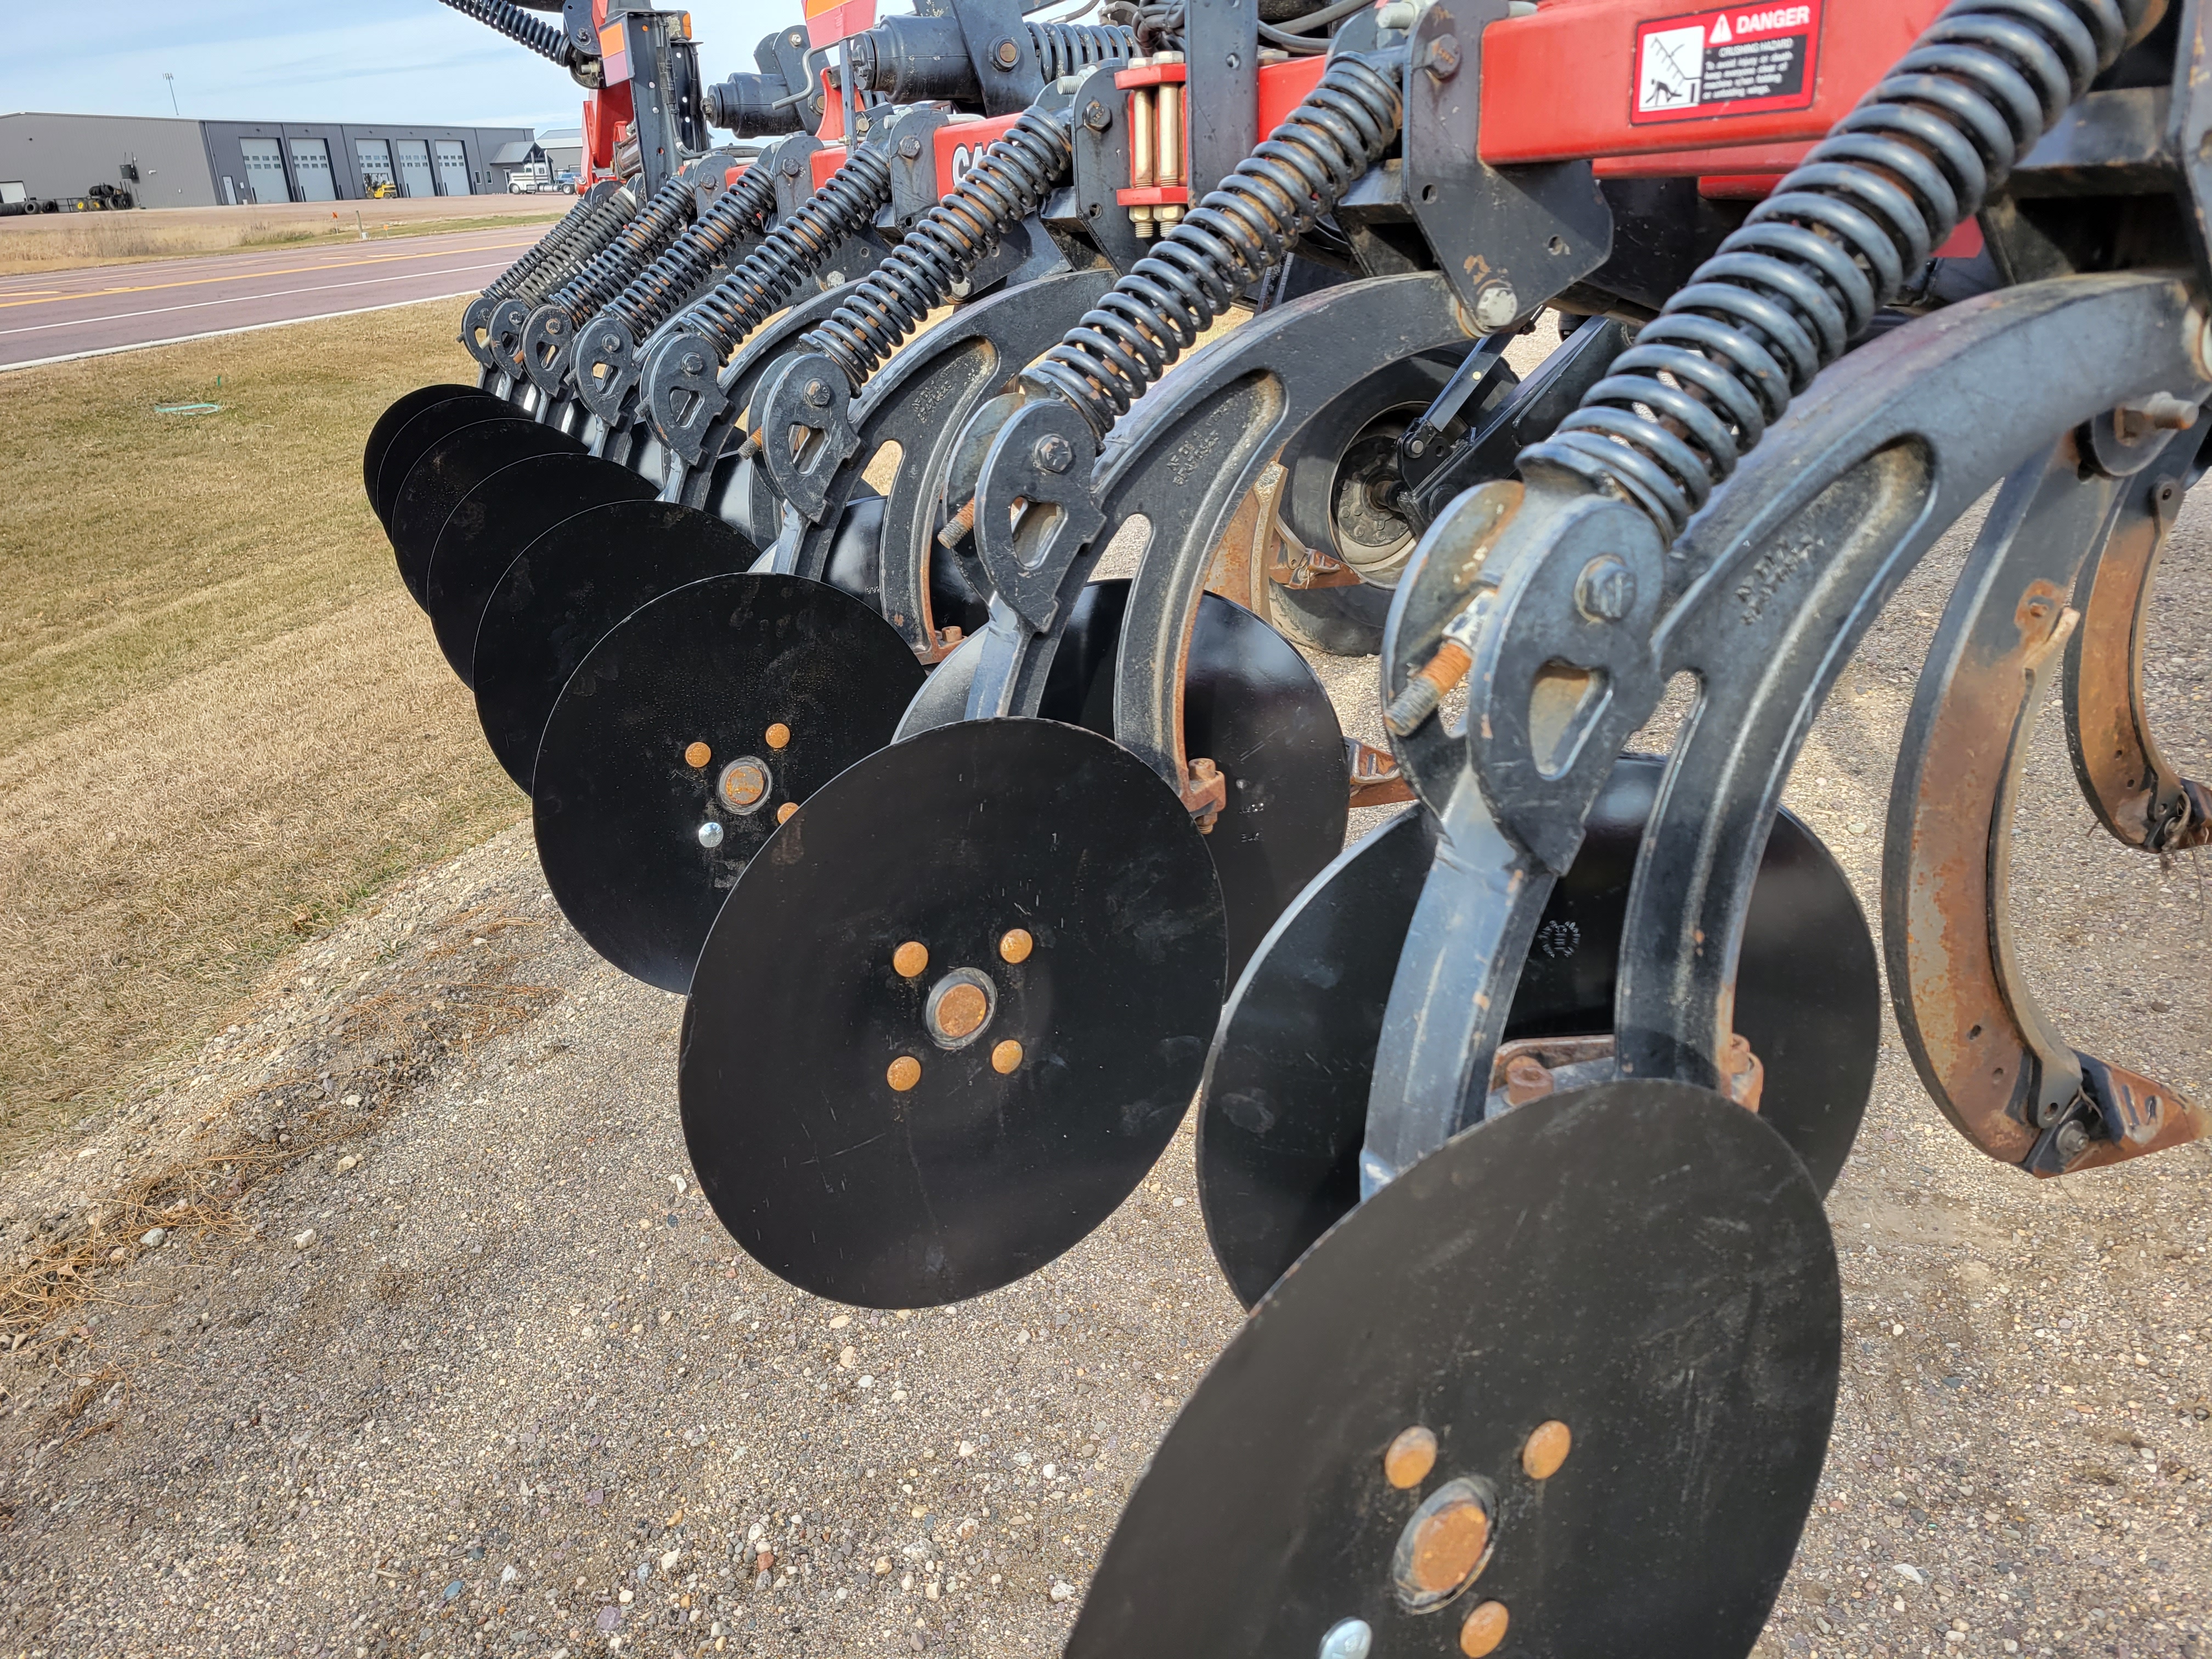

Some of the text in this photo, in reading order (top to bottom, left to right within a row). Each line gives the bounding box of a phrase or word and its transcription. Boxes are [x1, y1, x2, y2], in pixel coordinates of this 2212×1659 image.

[1736, 5, 1810, 34] DANGER
[1718, 37, 1794, 58] CRUSHING HAZARD
[1705, 50, 1794, 70] To avoid injury or death
[1703, 61, 1788, 81] keep everyone clear of
[1703, 80, 1733, 89] machine
[1756, 73, 1782, 84] folding
[1702, 92, 1712, 100] or
[1712, 87, 1746, 99] unfolding
